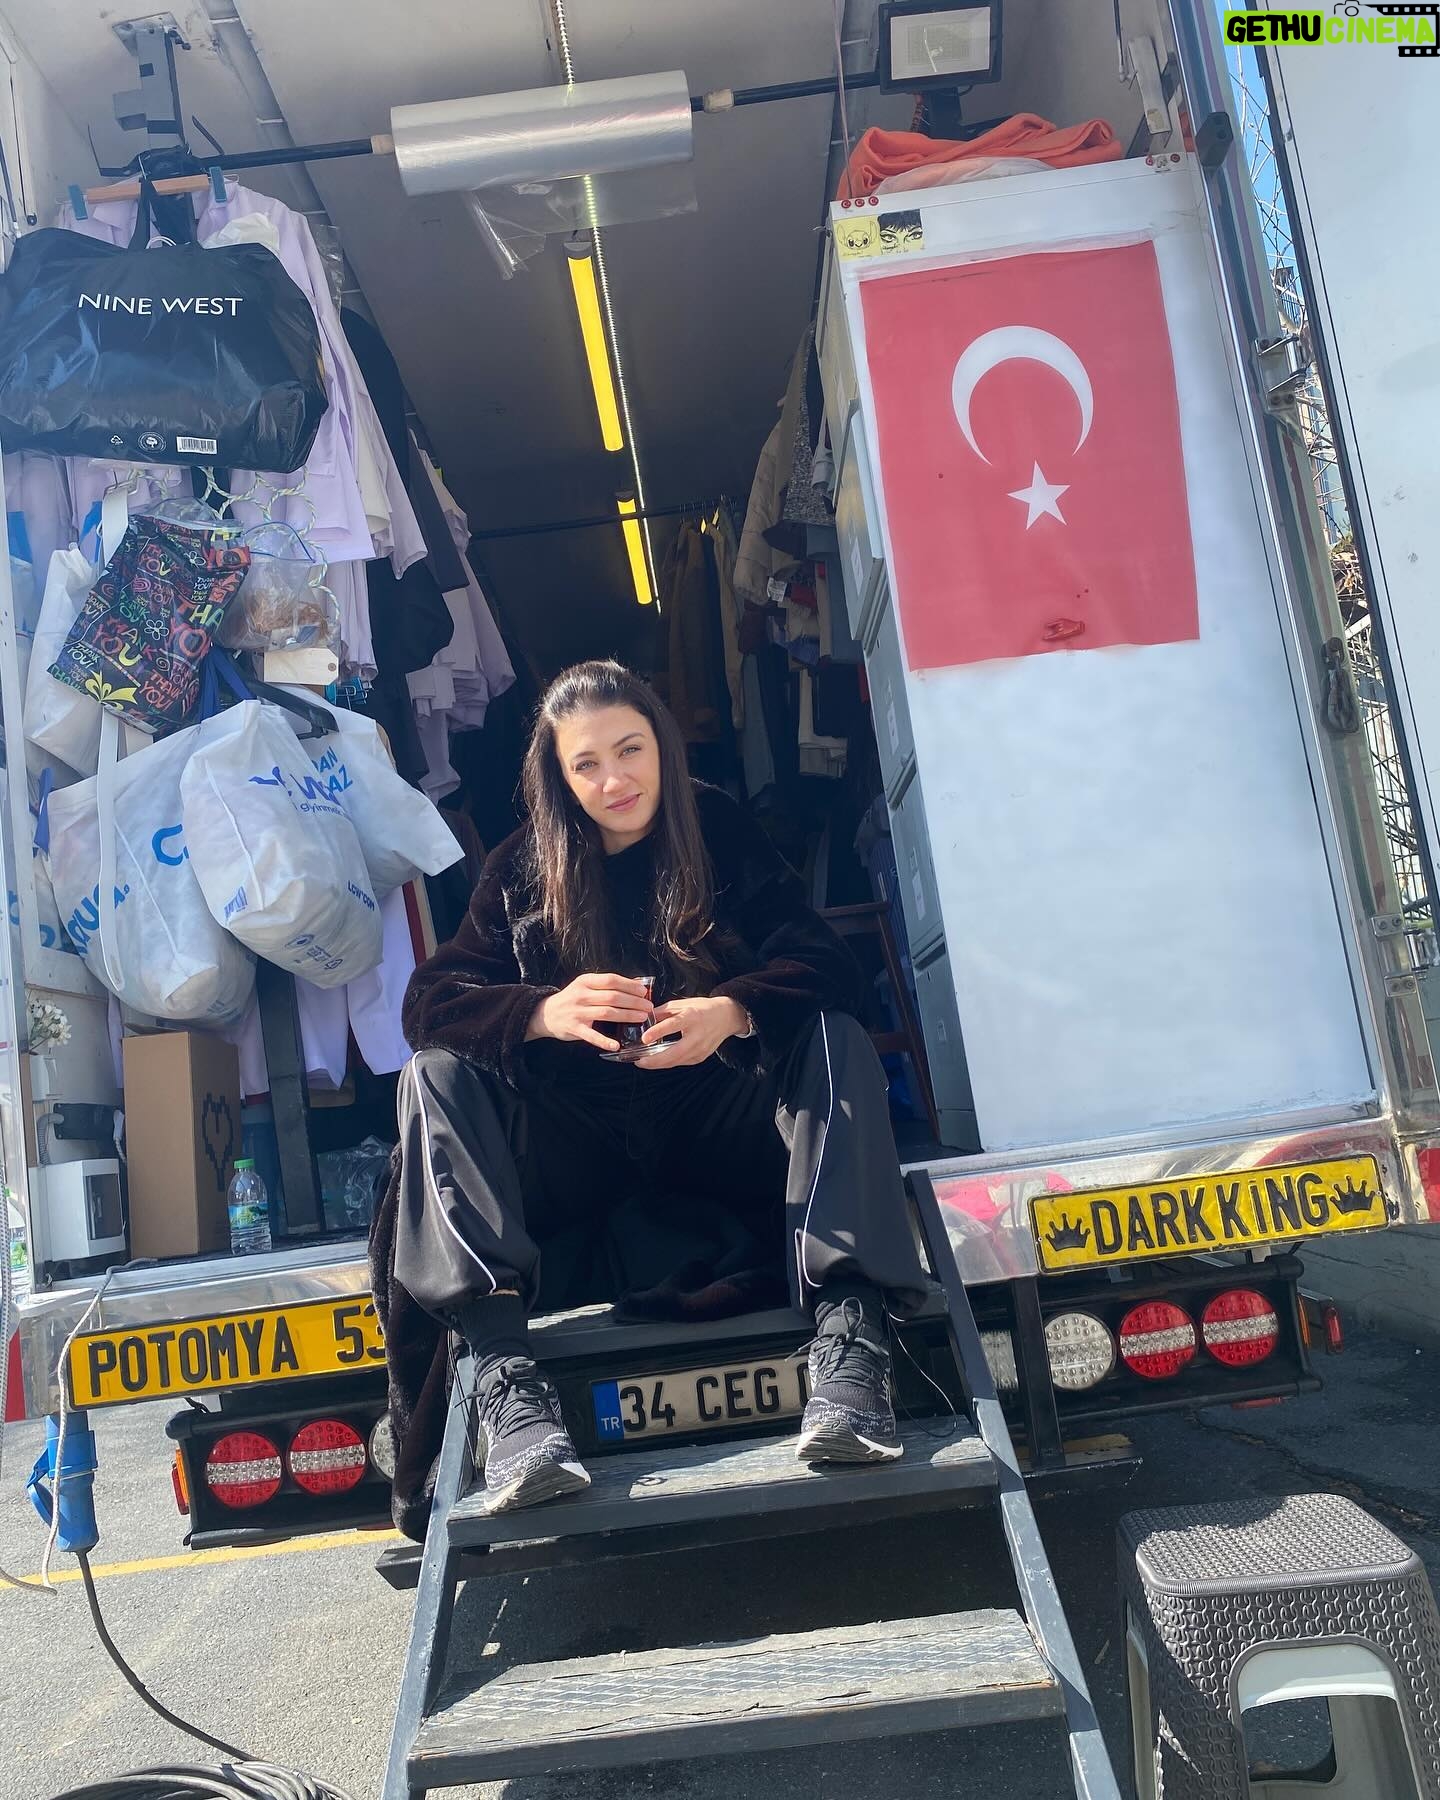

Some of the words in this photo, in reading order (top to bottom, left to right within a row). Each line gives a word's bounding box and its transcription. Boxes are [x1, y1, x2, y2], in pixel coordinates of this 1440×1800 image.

[78, 293, 152, 315] NINE
[161, 297, 243, 316] WEST
[176, 600, 225, 631] THA
[1090, 1187, 1215, 1255] DARK
[88, 1316, 300, 1397] POTOMYA
[601, 1415, 620, 1432] TR
[620, 1379, 676, 1433] 34
[696, 1367, 780, 1423] CEG
